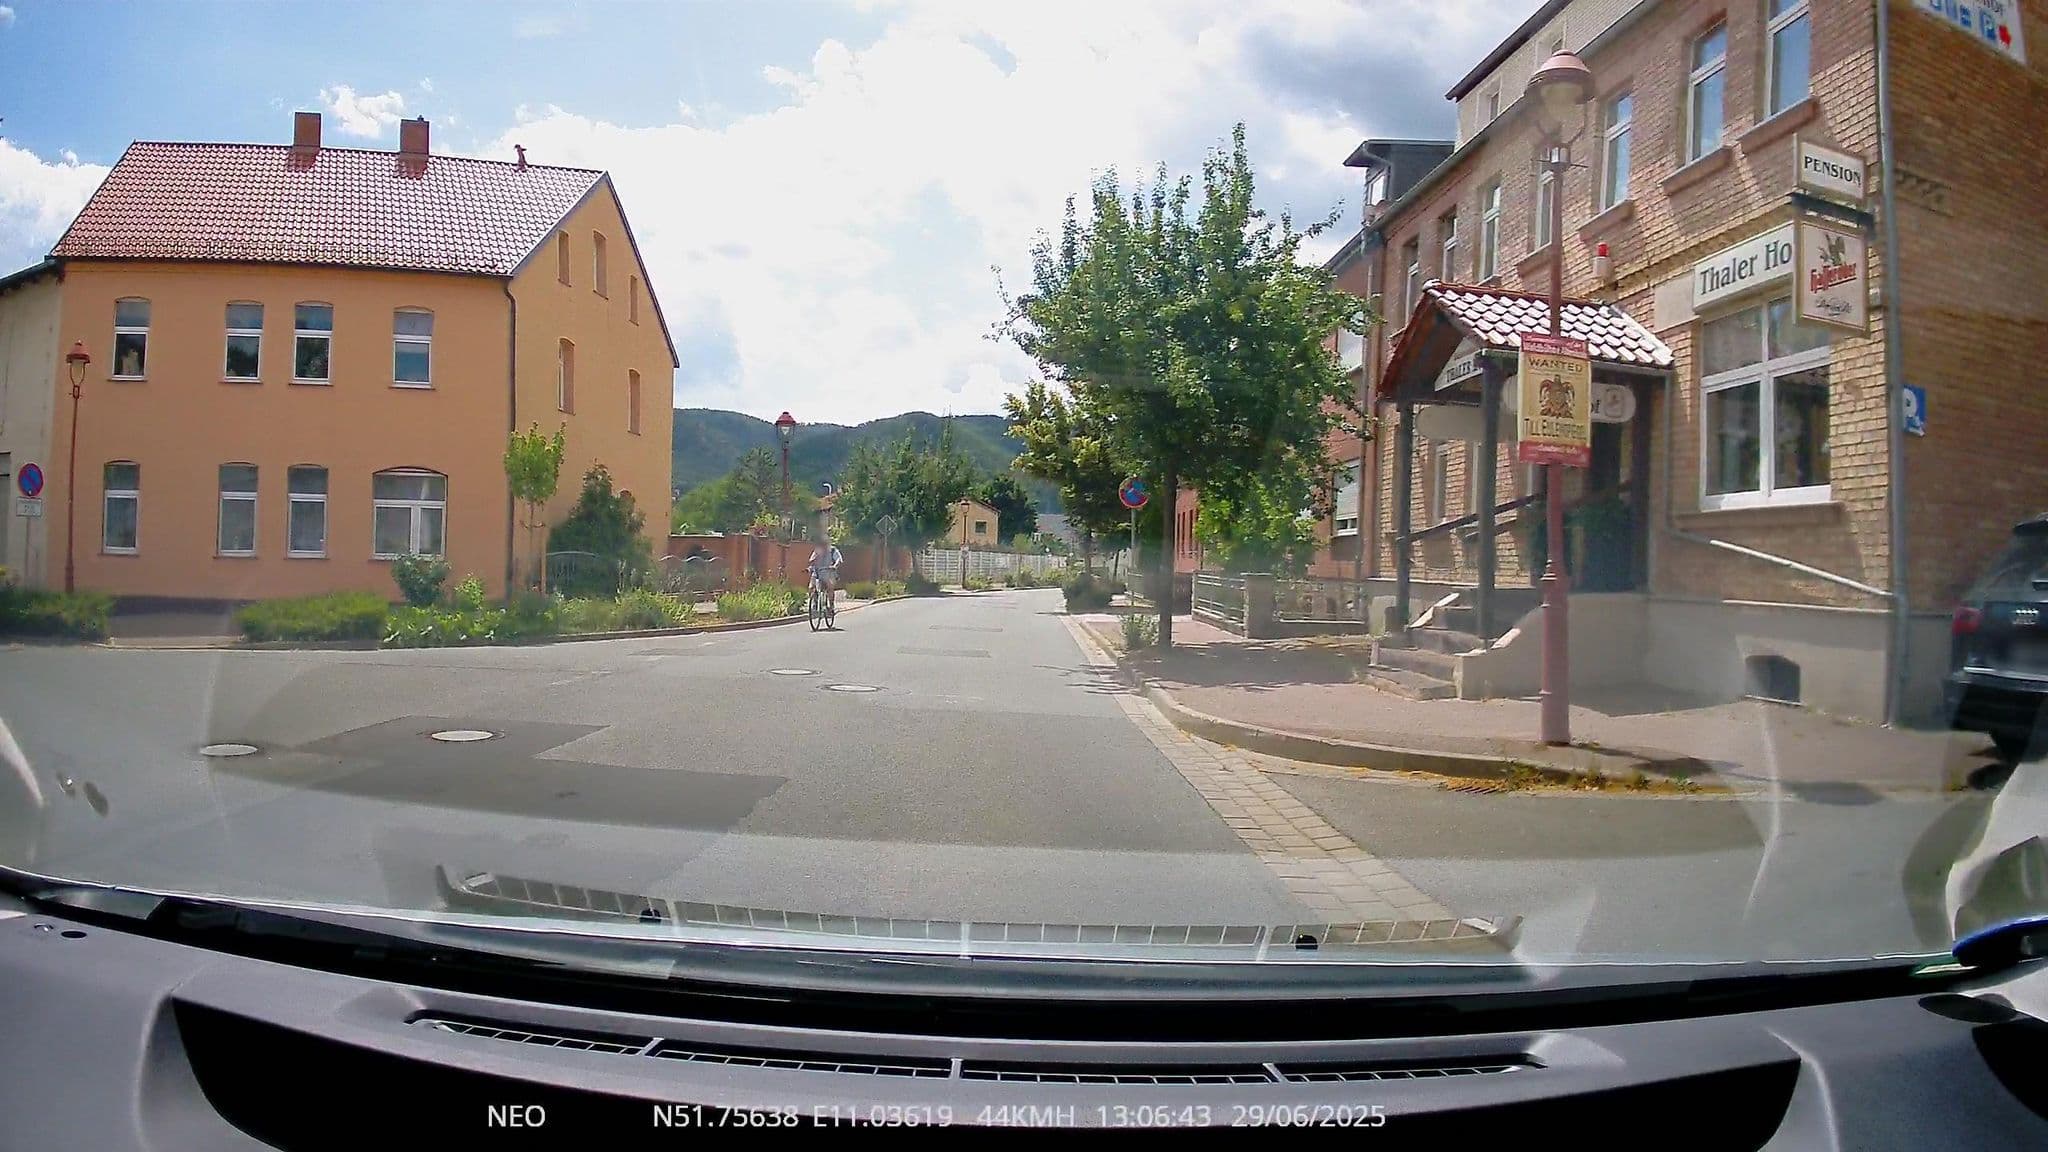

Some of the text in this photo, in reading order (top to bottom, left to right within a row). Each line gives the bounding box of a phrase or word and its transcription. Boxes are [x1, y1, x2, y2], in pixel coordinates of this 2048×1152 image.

[1803, 155, 1862, 187] PENSION
[1700, 239, 1793, 295] Thaler Ho
[1528, 357, 1584, 373] WANTED
